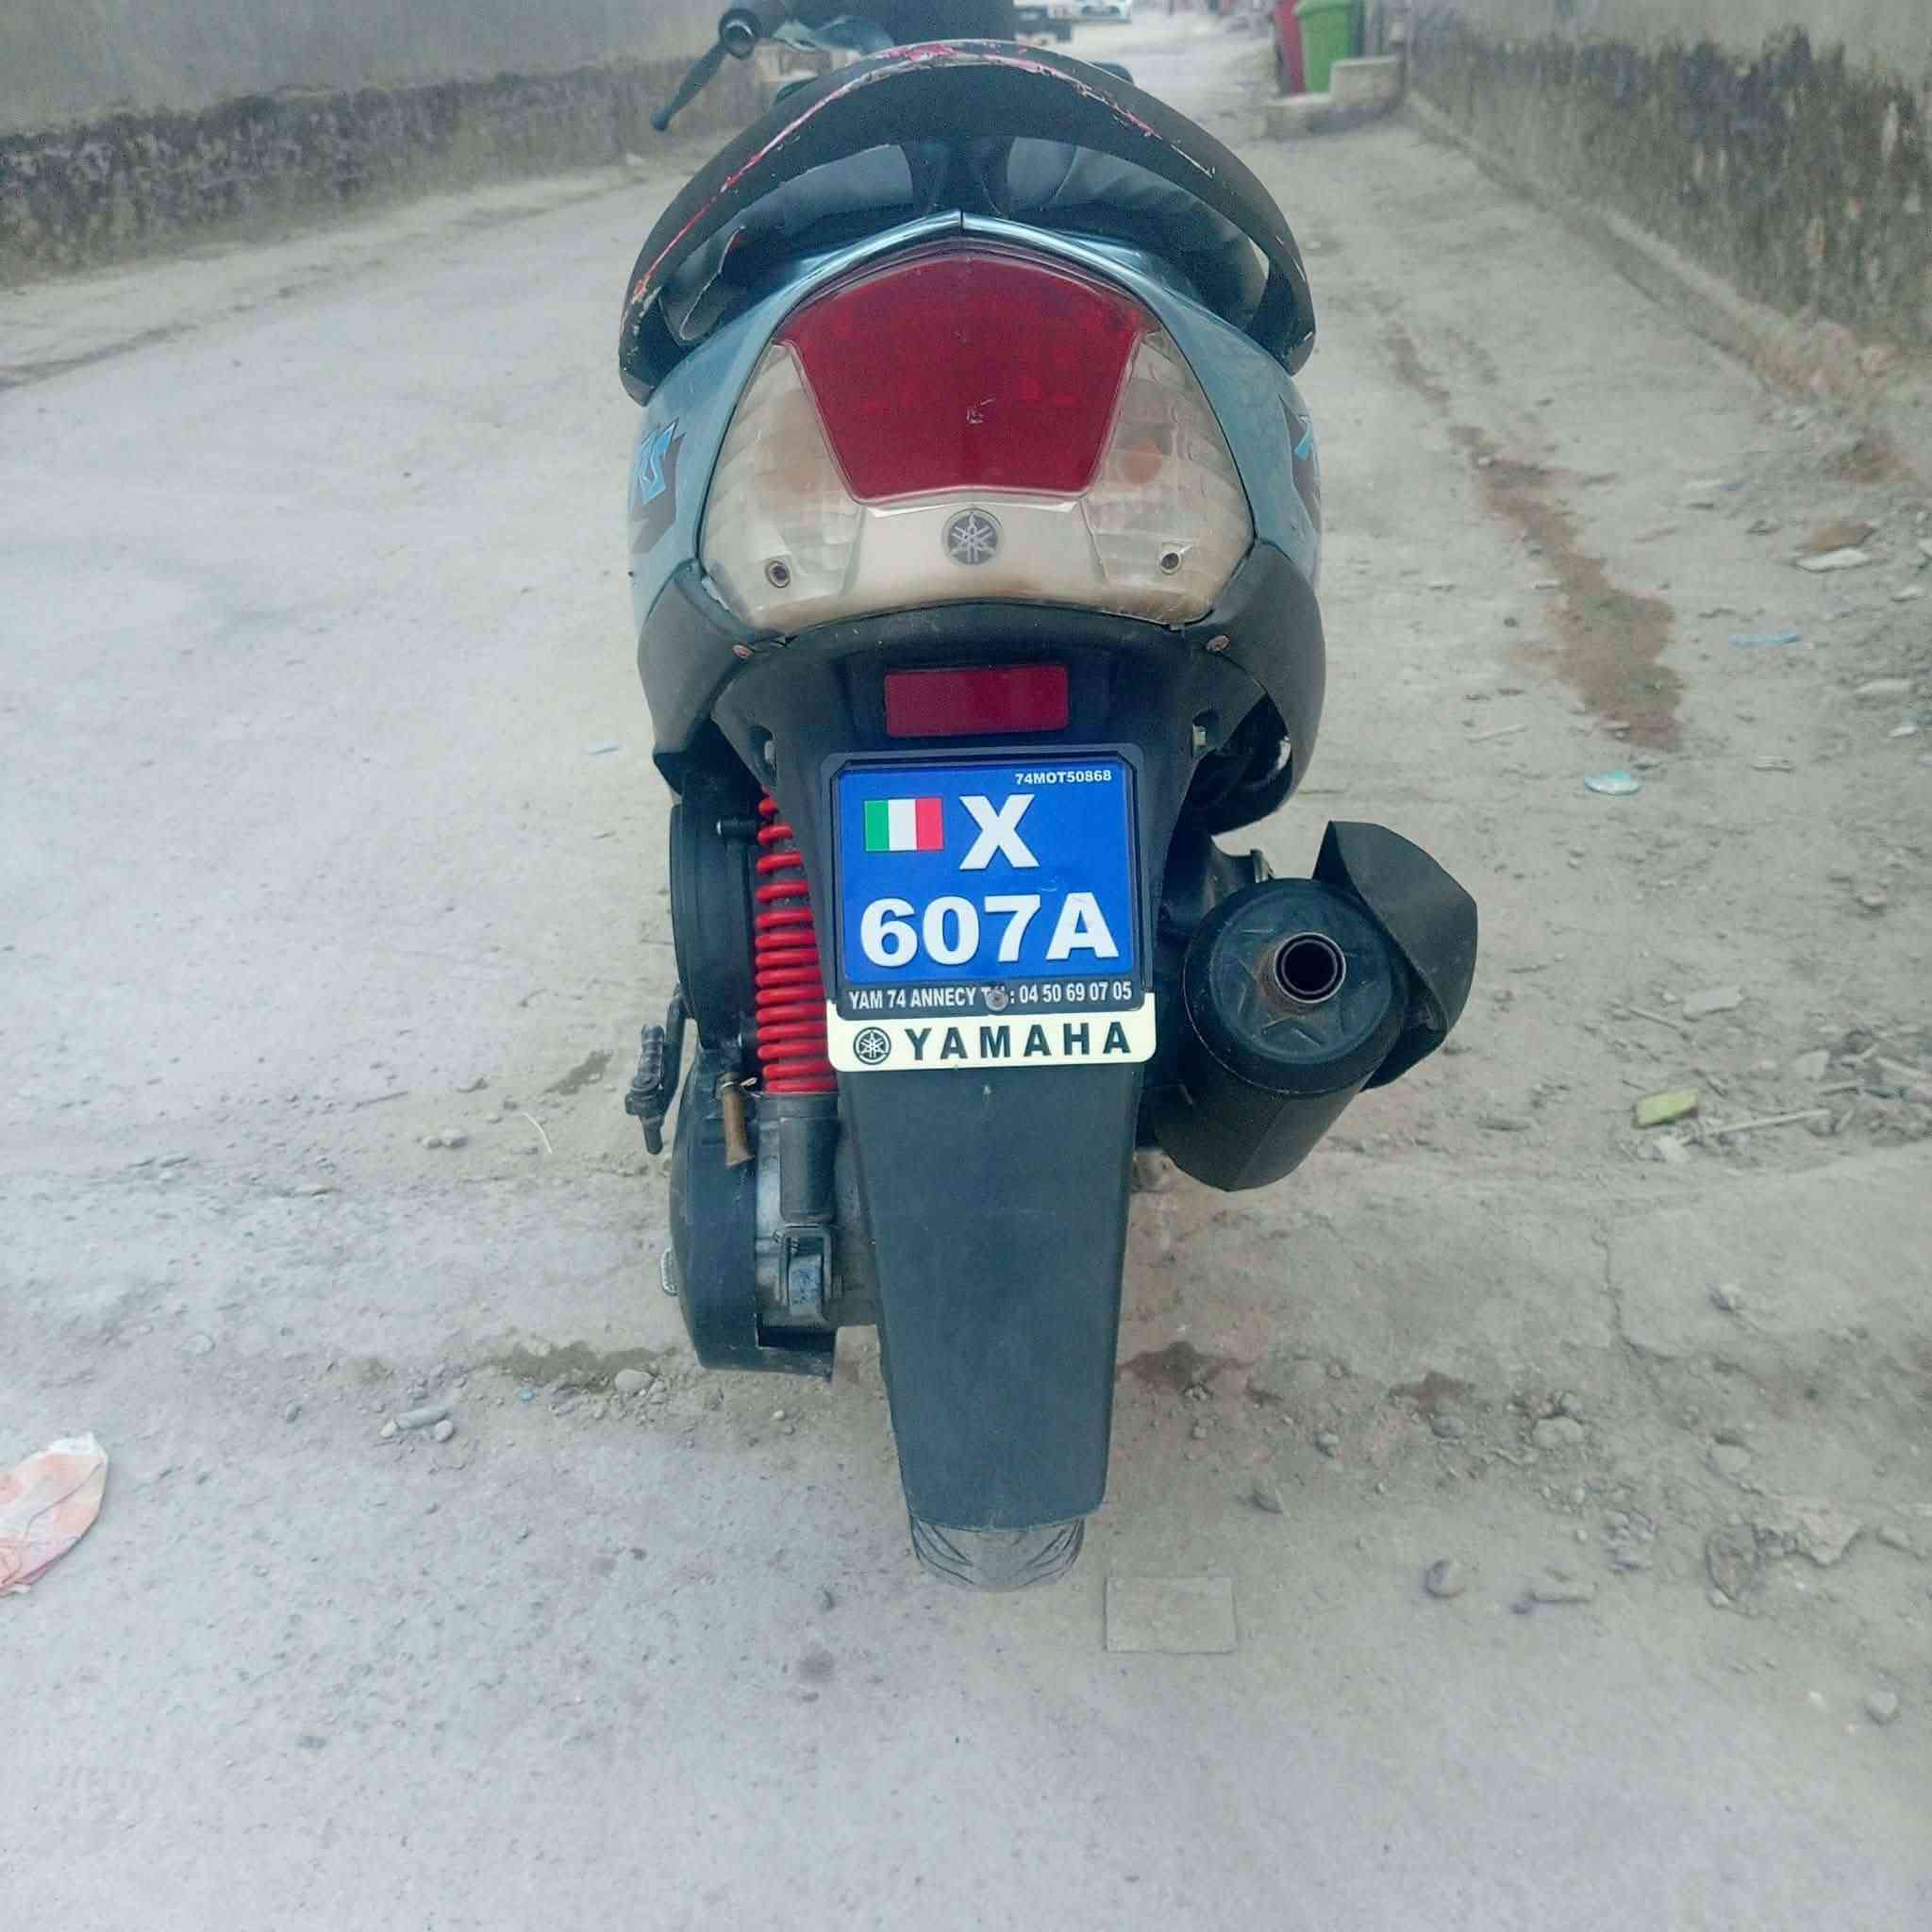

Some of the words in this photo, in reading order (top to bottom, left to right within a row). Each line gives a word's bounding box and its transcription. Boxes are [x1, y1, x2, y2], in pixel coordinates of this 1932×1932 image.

[1015, 770, 1112, 785] 74MOT50868
[958, 793, 1041, 870] X
[860, 891, 1120, 967] 607A
[849, 991, 883, 1009] YAM
[888, 990, 907, 1008] 74
[910, 987, 976, 1008] ANNECY
[1020, 984, 1039, 1004] 04
[1042, 983, 1062, 1003] 50
[1066, 982, 1086, 1002] 69
[1089, 981, 1108, 1001] 07
[1112, 980, 1132, 1000] 05
[904, 1021, 1131, 1061] YAMAHA
